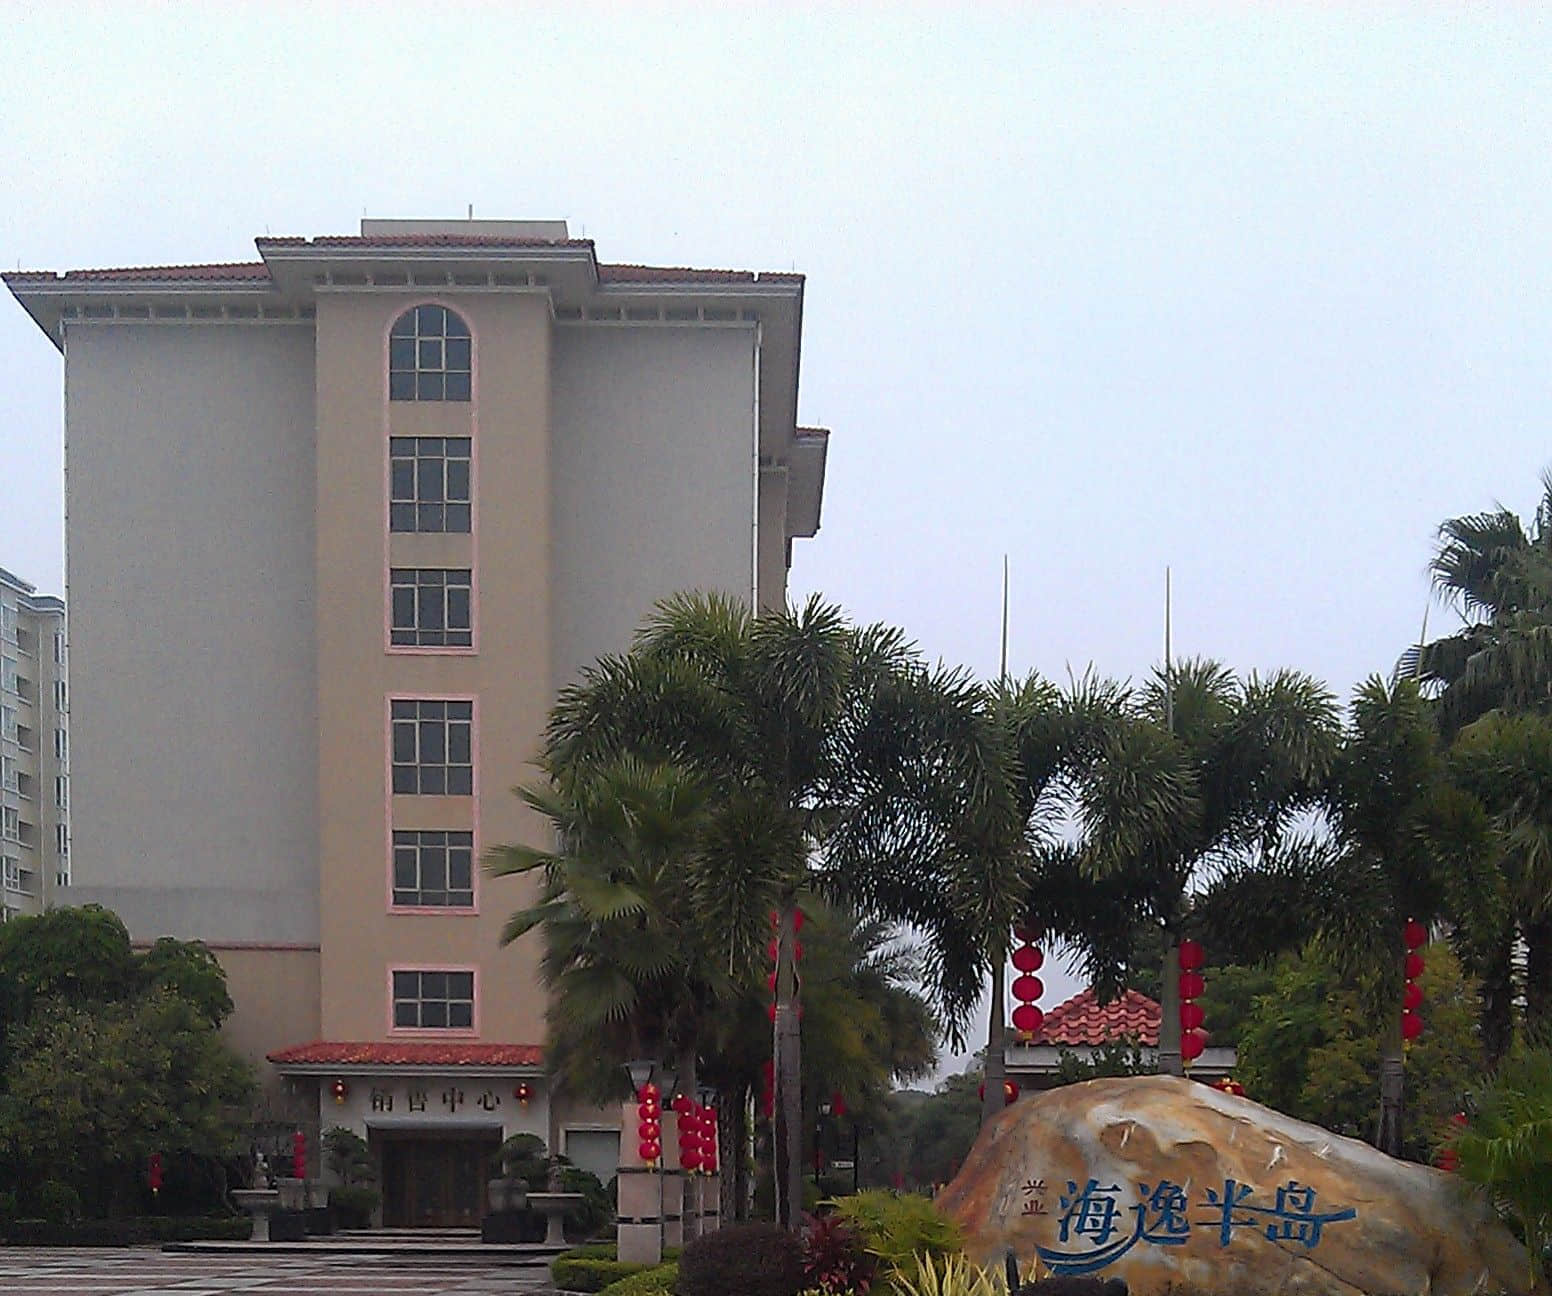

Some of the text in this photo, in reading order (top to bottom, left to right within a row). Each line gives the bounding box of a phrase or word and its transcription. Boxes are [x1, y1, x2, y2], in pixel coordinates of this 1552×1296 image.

[1021, 1178, 1049, 1217] 兴业
[1036, 1178, 1357, 1275] 海逸半岛
